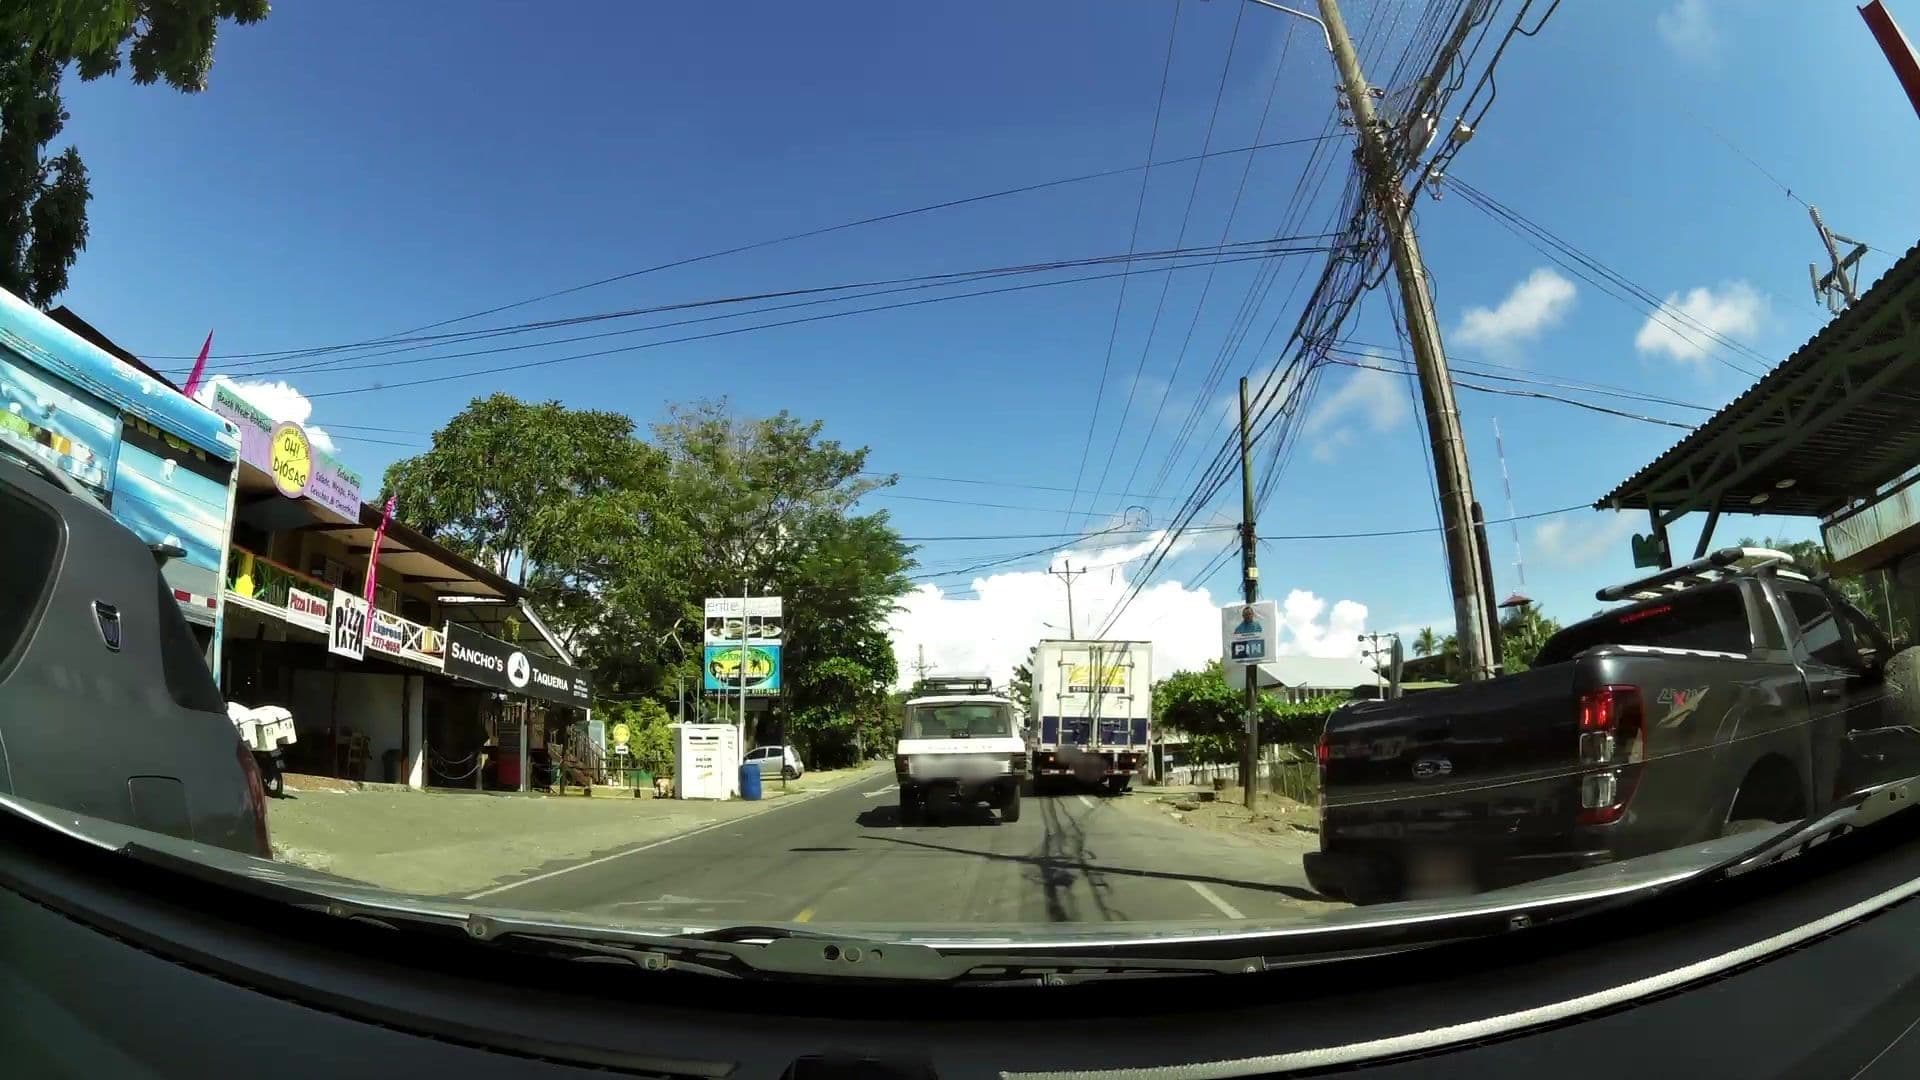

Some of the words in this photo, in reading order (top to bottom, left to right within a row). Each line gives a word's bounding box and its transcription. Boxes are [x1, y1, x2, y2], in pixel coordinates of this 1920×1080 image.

[284, 437, 300, 458] OH!
[273, 456, 305, 487] DIOSAS
[532, 668, 569, 691] TAQUERIA
